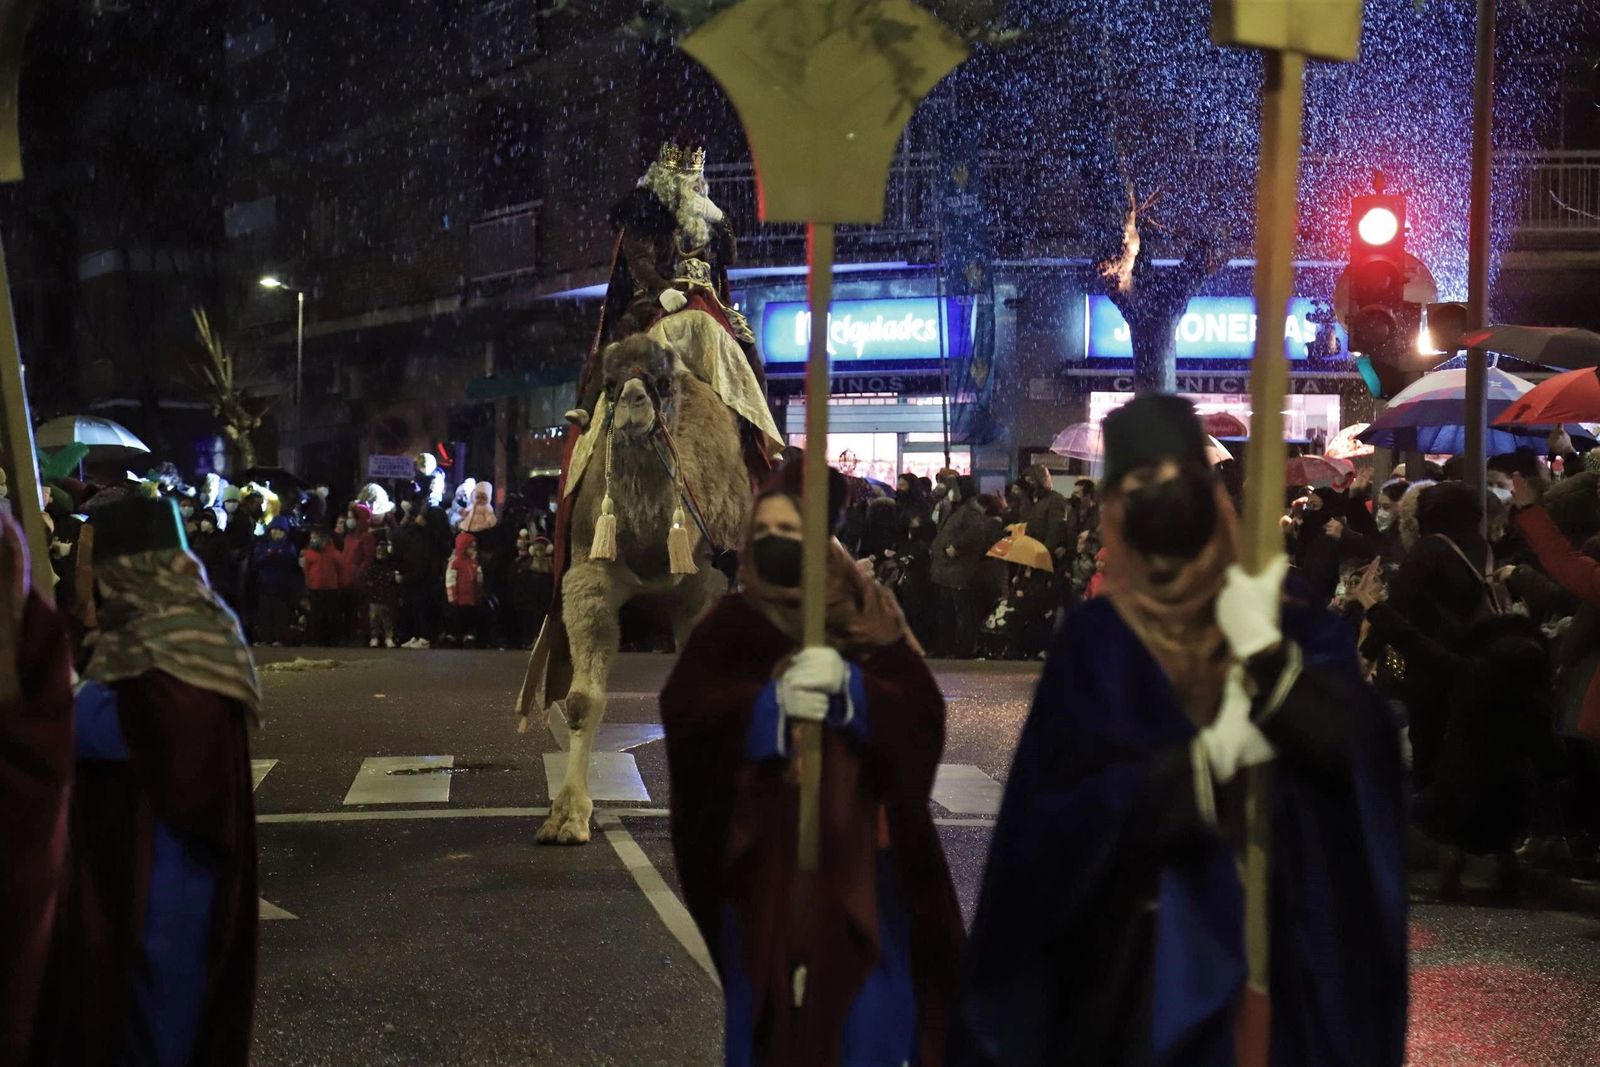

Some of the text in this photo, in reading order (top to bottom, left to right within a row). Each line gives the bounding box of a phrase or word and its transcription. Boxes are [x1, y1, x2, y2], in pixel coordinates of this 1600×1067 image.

[1114, 313, 1317, 342] JONEAS
[830, 377, 903, 392] INOS
[1113, 377, 1321, 393] CNICIA
